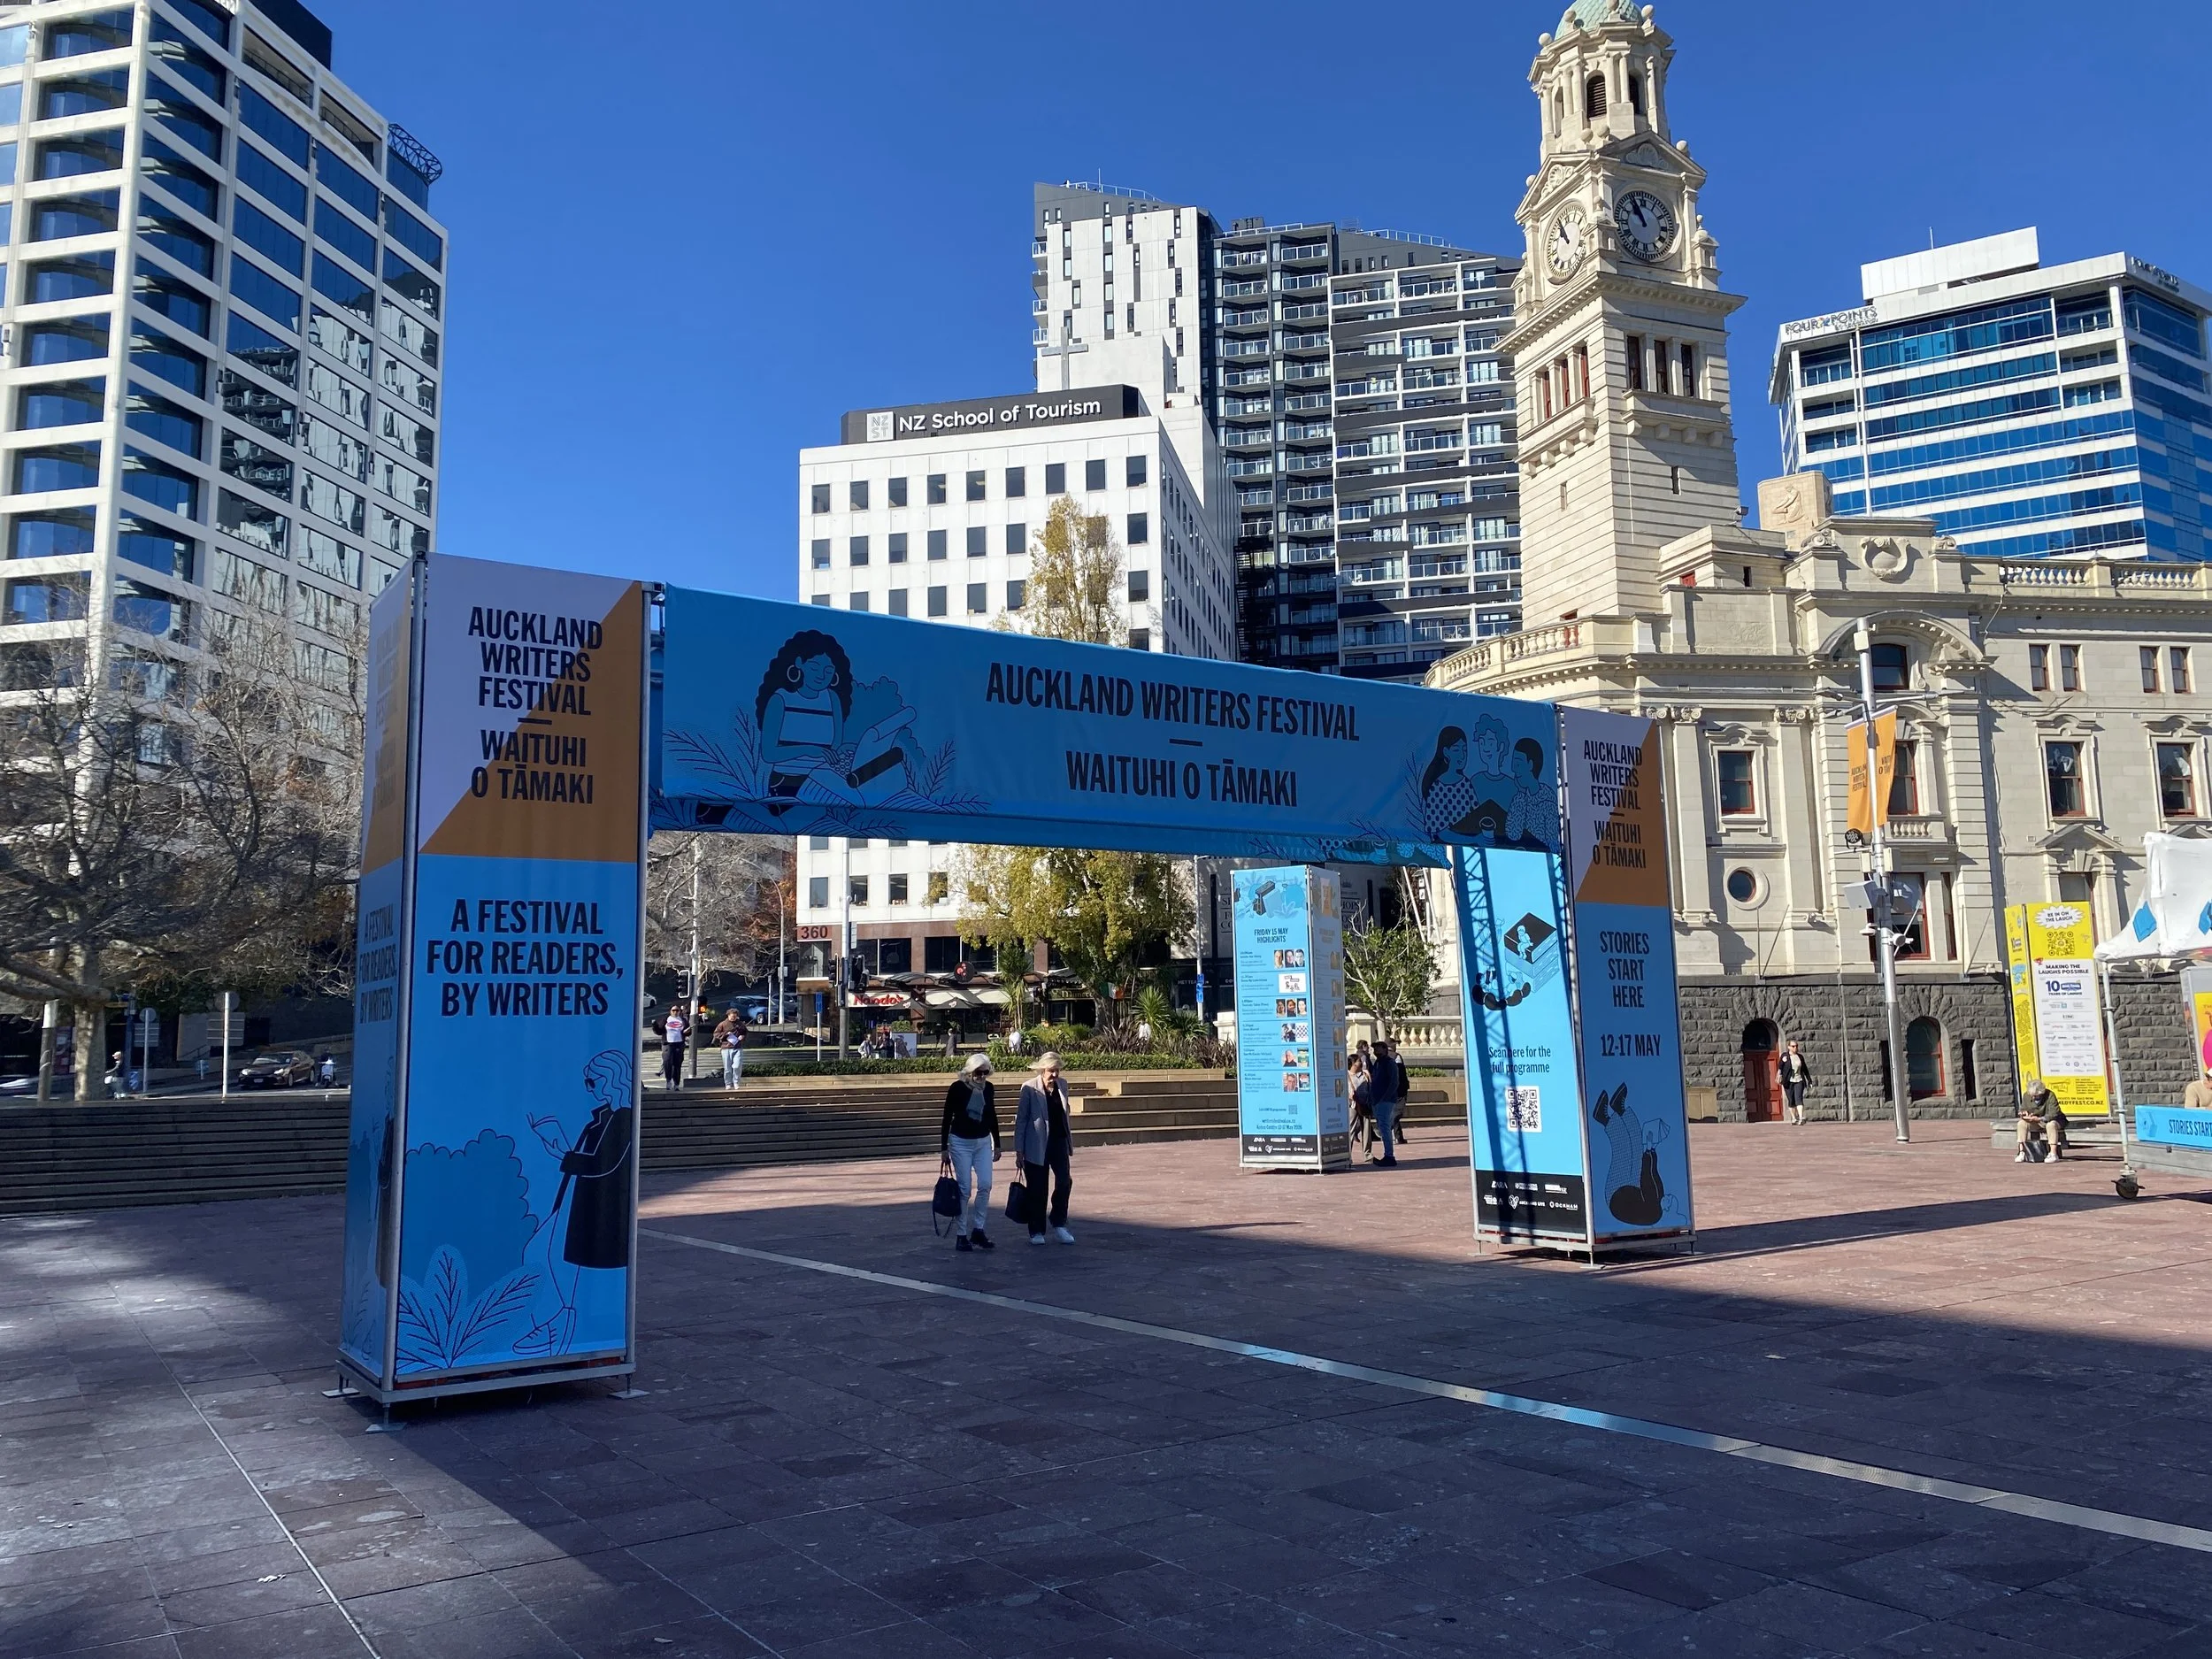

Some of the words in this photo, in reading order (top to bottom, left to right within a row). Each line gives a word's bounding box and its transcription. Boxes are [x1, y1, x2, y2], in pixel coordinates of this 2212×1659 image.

[1786, 319, 1818, 334] FOUR
[1831, 306, 1878, 326] POINTS
[900, 415, 926, 432] NZ
[932, 408, 995, 429] School
[1000, 406, 1021, 423] of
[1025, 400, 1101, 419] Tourism
[468, 606, 603, 649] AUCKLAND
[480, 641, 591, 682] WRITERS
[479, 676, 591, 716] FESTIVAL
[986, 662, 1133, 717] AUCKLAND
[1141, 680, 1251, 730] WRITERS
[1256, 695, 1360, 741] FESTIVAL
[480, 729, 586, 767] WAITUHI
[1584, 740, 1642, 766] AUCKLAND
[471, 766, 488, 798] O
[497, 764, 593, 804] TĀMAKI
[1065, 750, 1176, 798] WAITUHI
[1183, 762, 1200, 800] O
[1206, 758, 1297, 807] TĀMAKI
[1590, 762, 1640, 787] WRITERS
[1591, 785, 1641, 810] FESTIVAL
[1594, 820, 1641, 844] WAITUHI
[1593, 844, 1601, 865] O
[1603, 842, 1646, 869] TĀMAKI
[450, 899, 470, 933] A
[478, 899, 603, 934] FESTIVAL
[801, 926, 828, 940] 360
[1600, 931, 1650, 955] STORIES
[426, 940, 484, 974] FOR
[491, 941, 623, 979] READERS,
[1608, 957, 1644, 981] START
[442, 982, 480, 1016] BY
[487, 982, 608, 1016] WRITERS
[1612, 985, 1645, 1008] HERE
[2046, 980, 2060, 992] 10
[1489, 1047, 1507, 1058] Scan
[1508, 1047, 1525, 1058] here
[1526, 1046, 1537, 1057] for
[1538, 1046, 1551, 1057] the
[1601, 1033, 1632, 1056] 12-17
[1635, 1033, 1661, 1056] MAY
[1492, 1063, 1504, 1073] full
[1506, 1064, 1550, 1076] programme
[2169, 1119, 2193, 1136] STORIES
